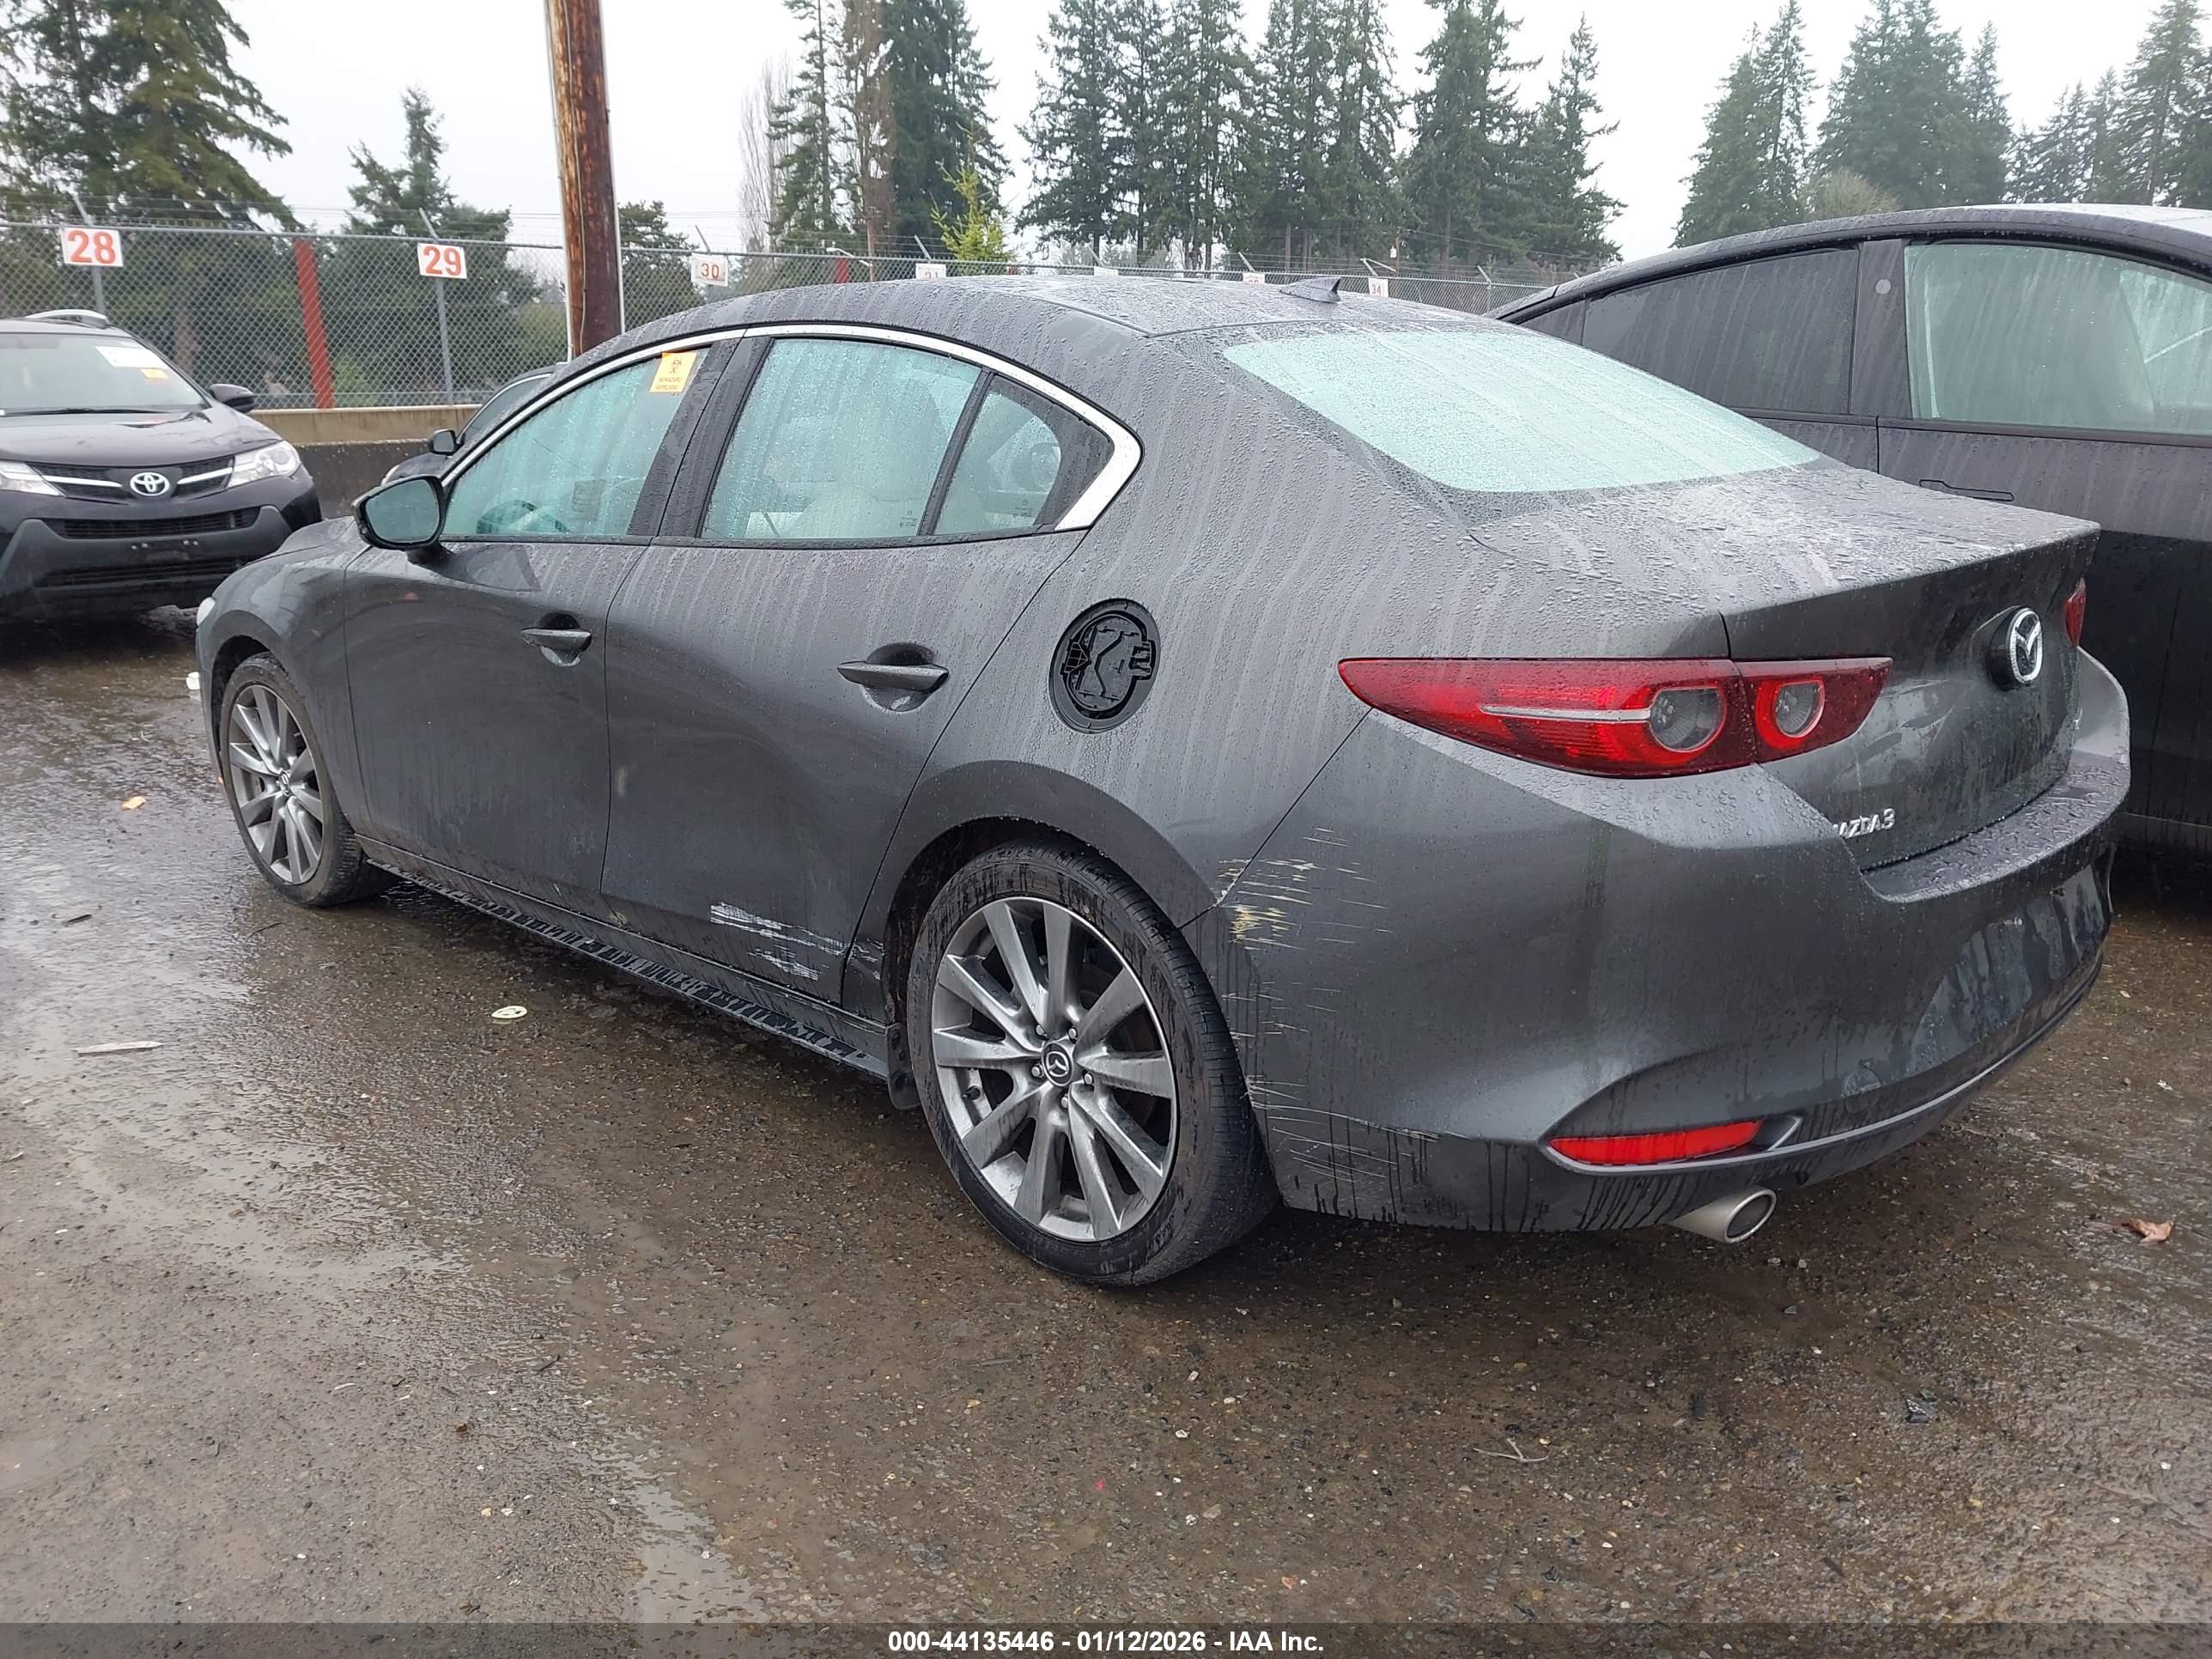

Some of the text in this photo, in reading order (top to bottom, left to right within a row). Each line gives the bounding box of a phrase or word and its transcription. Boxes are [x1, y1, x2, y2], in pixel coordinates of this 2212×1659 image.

[69, 229, 116, 264] 28
[424, 246, 461, 276] 29
[701, 263, 720, 279] 30
